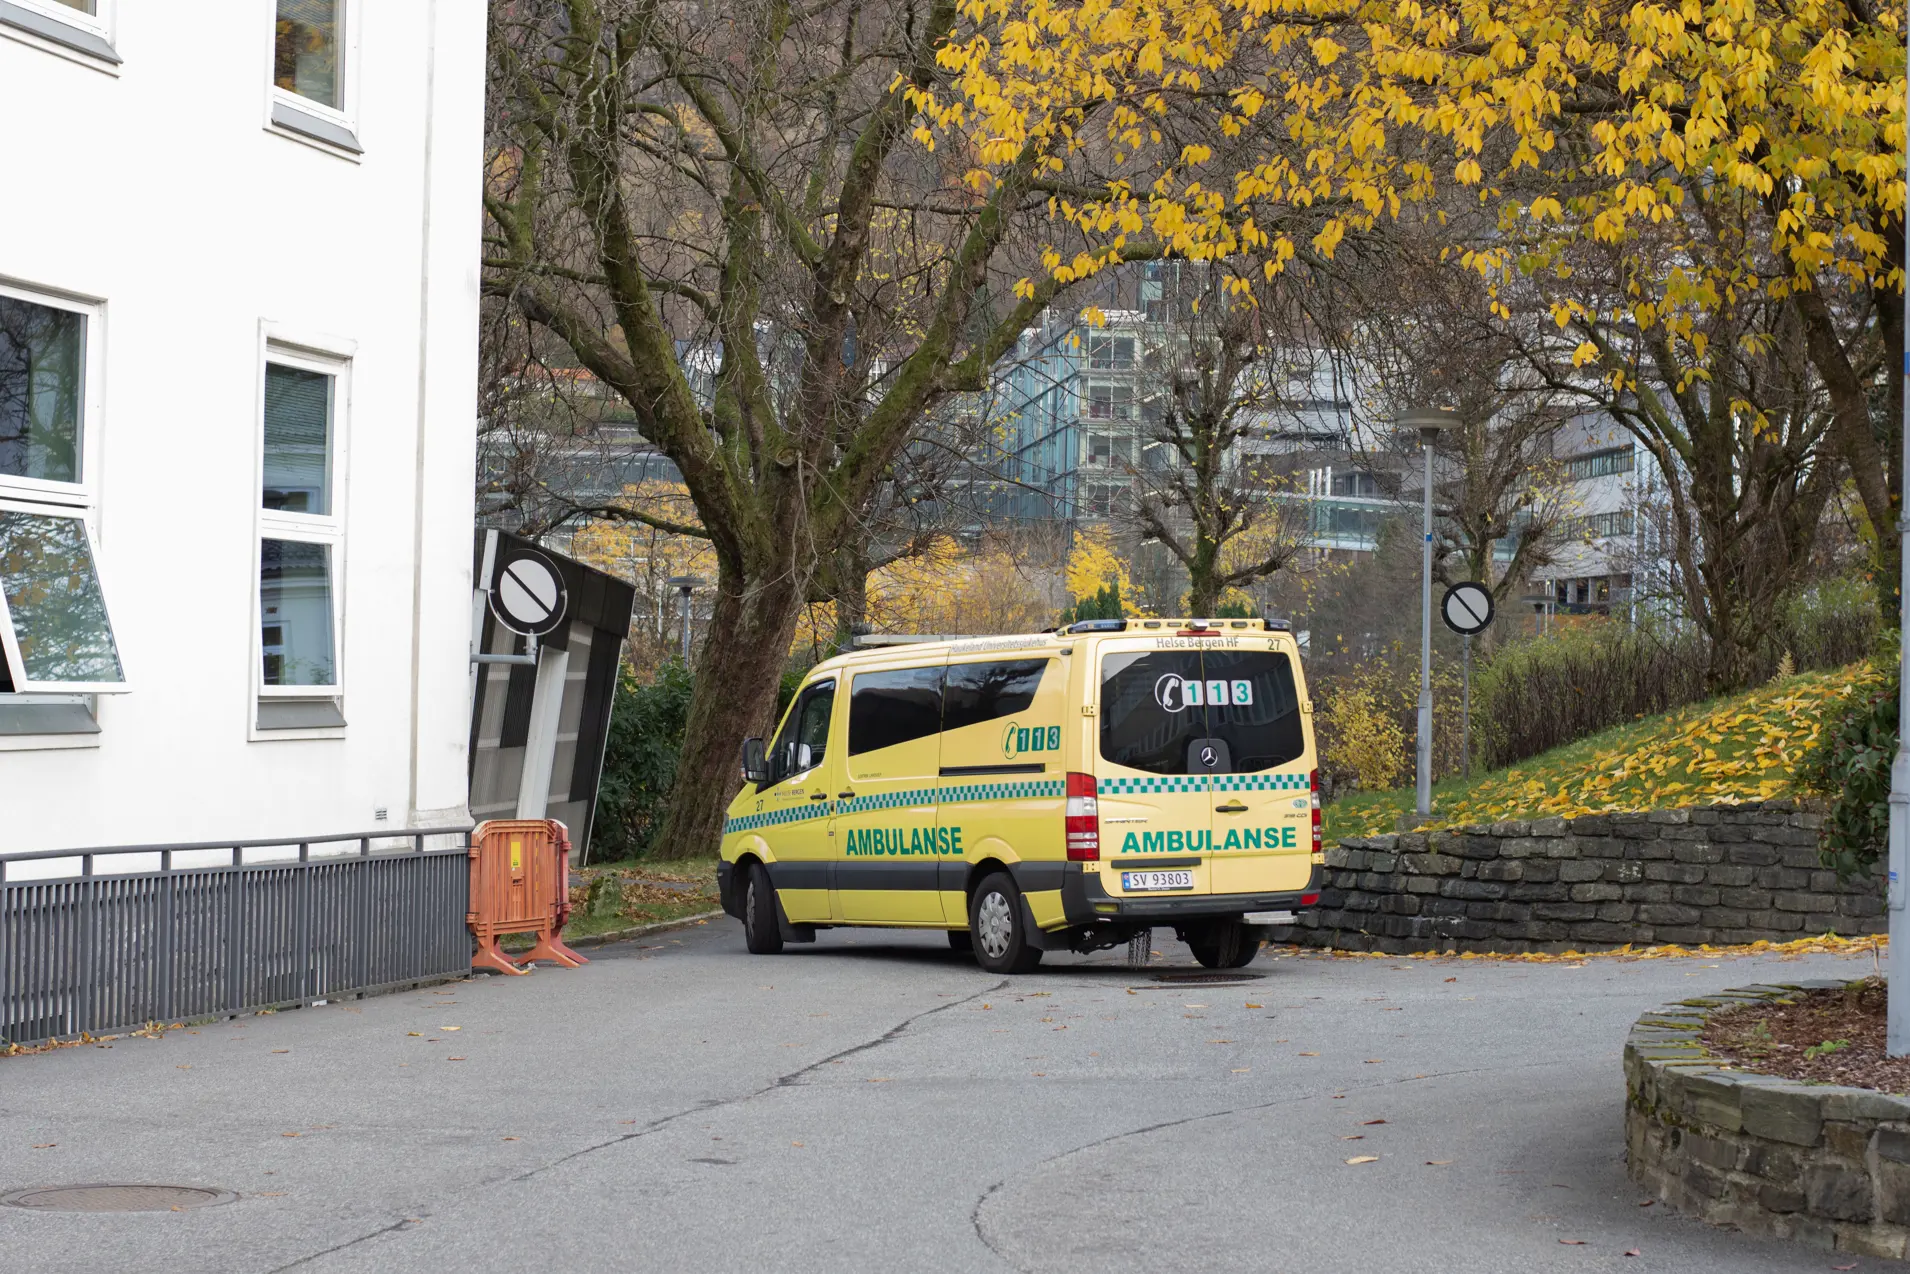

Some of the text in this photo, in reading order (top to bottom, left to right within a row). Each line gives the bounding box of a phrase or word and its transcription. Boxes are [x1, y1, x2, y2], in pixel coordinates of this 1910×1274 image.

[1156, 636, 1239, 650] Helse Bergen HF
[1267, 638, 1281, 650] 27
[1186, 682, 1250, 704] 113
[1018, 727, 1060, 751] 113
[756, 800, 764, 811] 27
[846, 827, 963, 856] AMBULANSE
[1121, 827, 1296, 853] AMBULANSE
[1133, 873, 1189, 886] SV 93803
